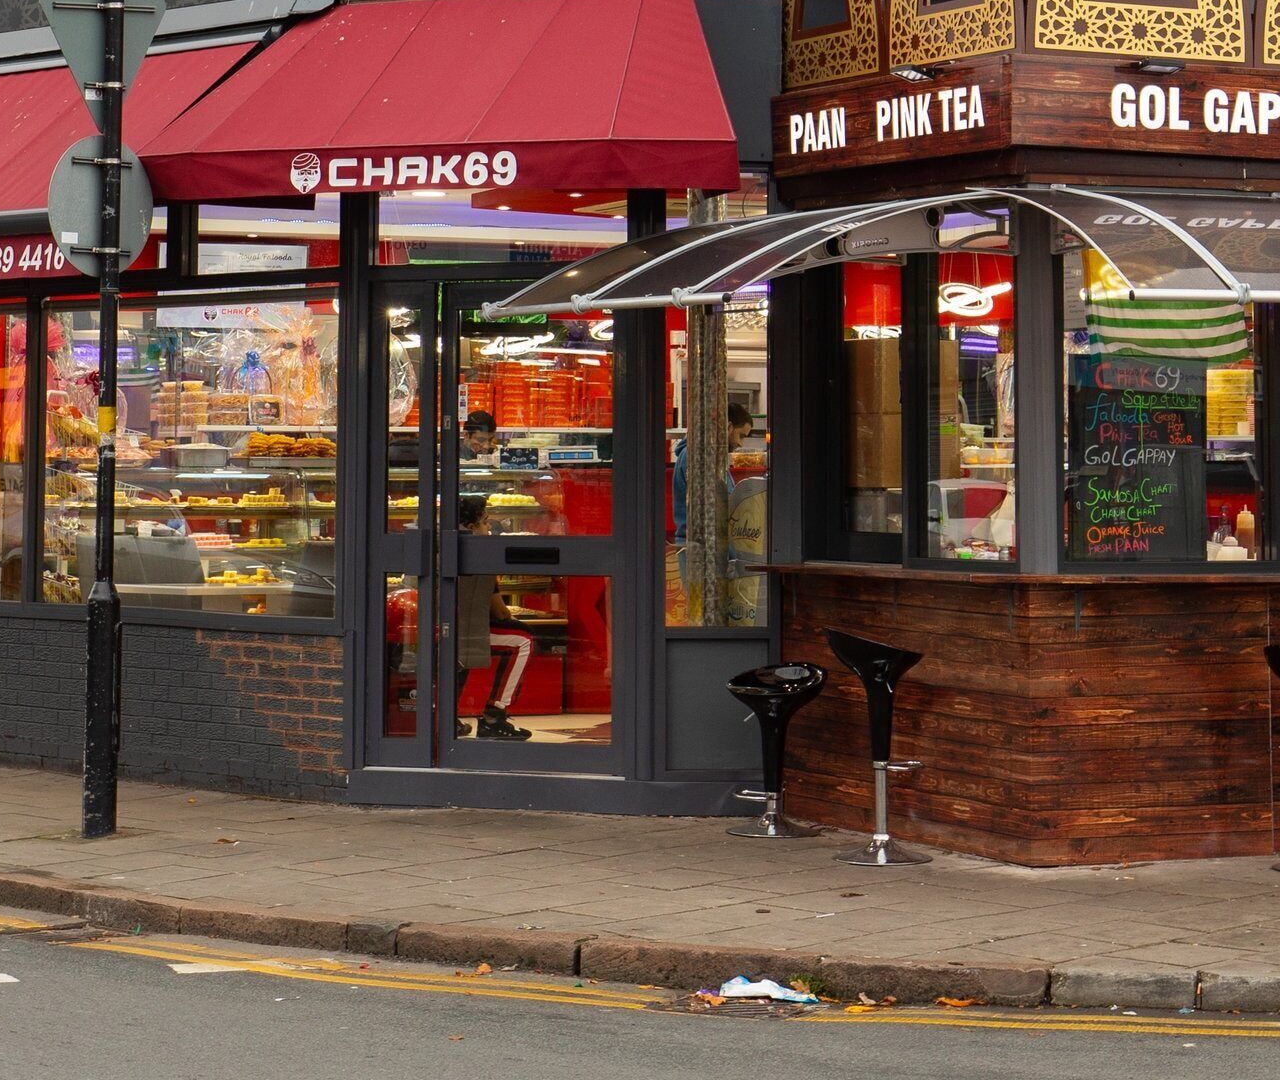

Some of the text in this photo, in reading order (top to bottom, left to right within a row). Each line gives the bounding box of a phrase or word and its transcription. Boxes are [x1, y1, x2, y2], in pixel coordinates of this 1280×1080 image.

[789, 85, 986, 155] PAAN PINK TEA
[1111, 83, 1190, 131] GOL
[328, 150, 517, 187] CHAK69
[17, 242, 65, 271] 4416
[1155, 365, 1180, 390] 69
[1121, 388, 1158, 412] Soup
